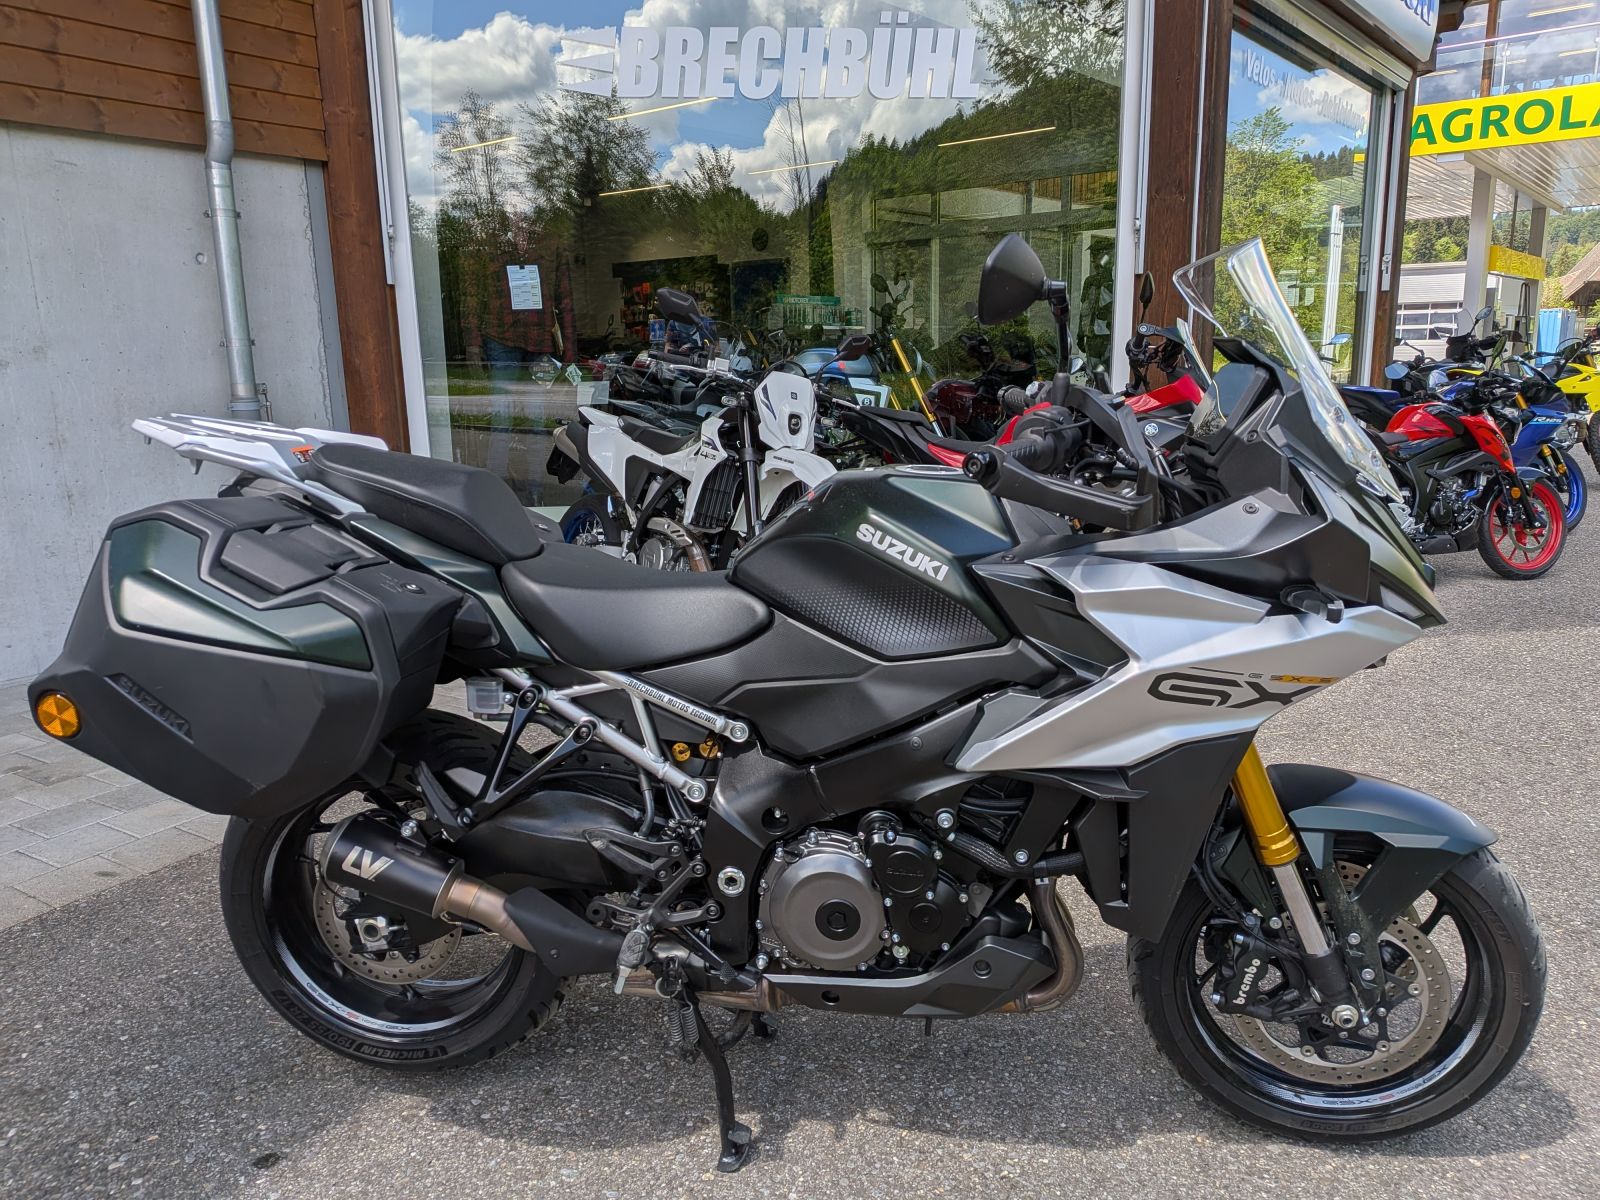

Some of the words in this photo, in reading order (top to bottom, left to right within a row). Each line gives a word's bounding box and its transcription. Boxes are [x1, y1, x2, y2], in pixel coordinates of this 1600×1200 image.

[617, 11, 980, 100] BRECHBÜHL
[856, 523, 949, 582] SUZUKI
[628, 679, 666, 703] BRECHBÜHL
[665, 697, 691, 714] MOTOS
[690, 708, 718, 726] EGGIWIL
[341, 845, 394, 881] LV
[1232, 958, 1261, 1005] brembo
[360, 1045, 424, 1060] MICHELIN
